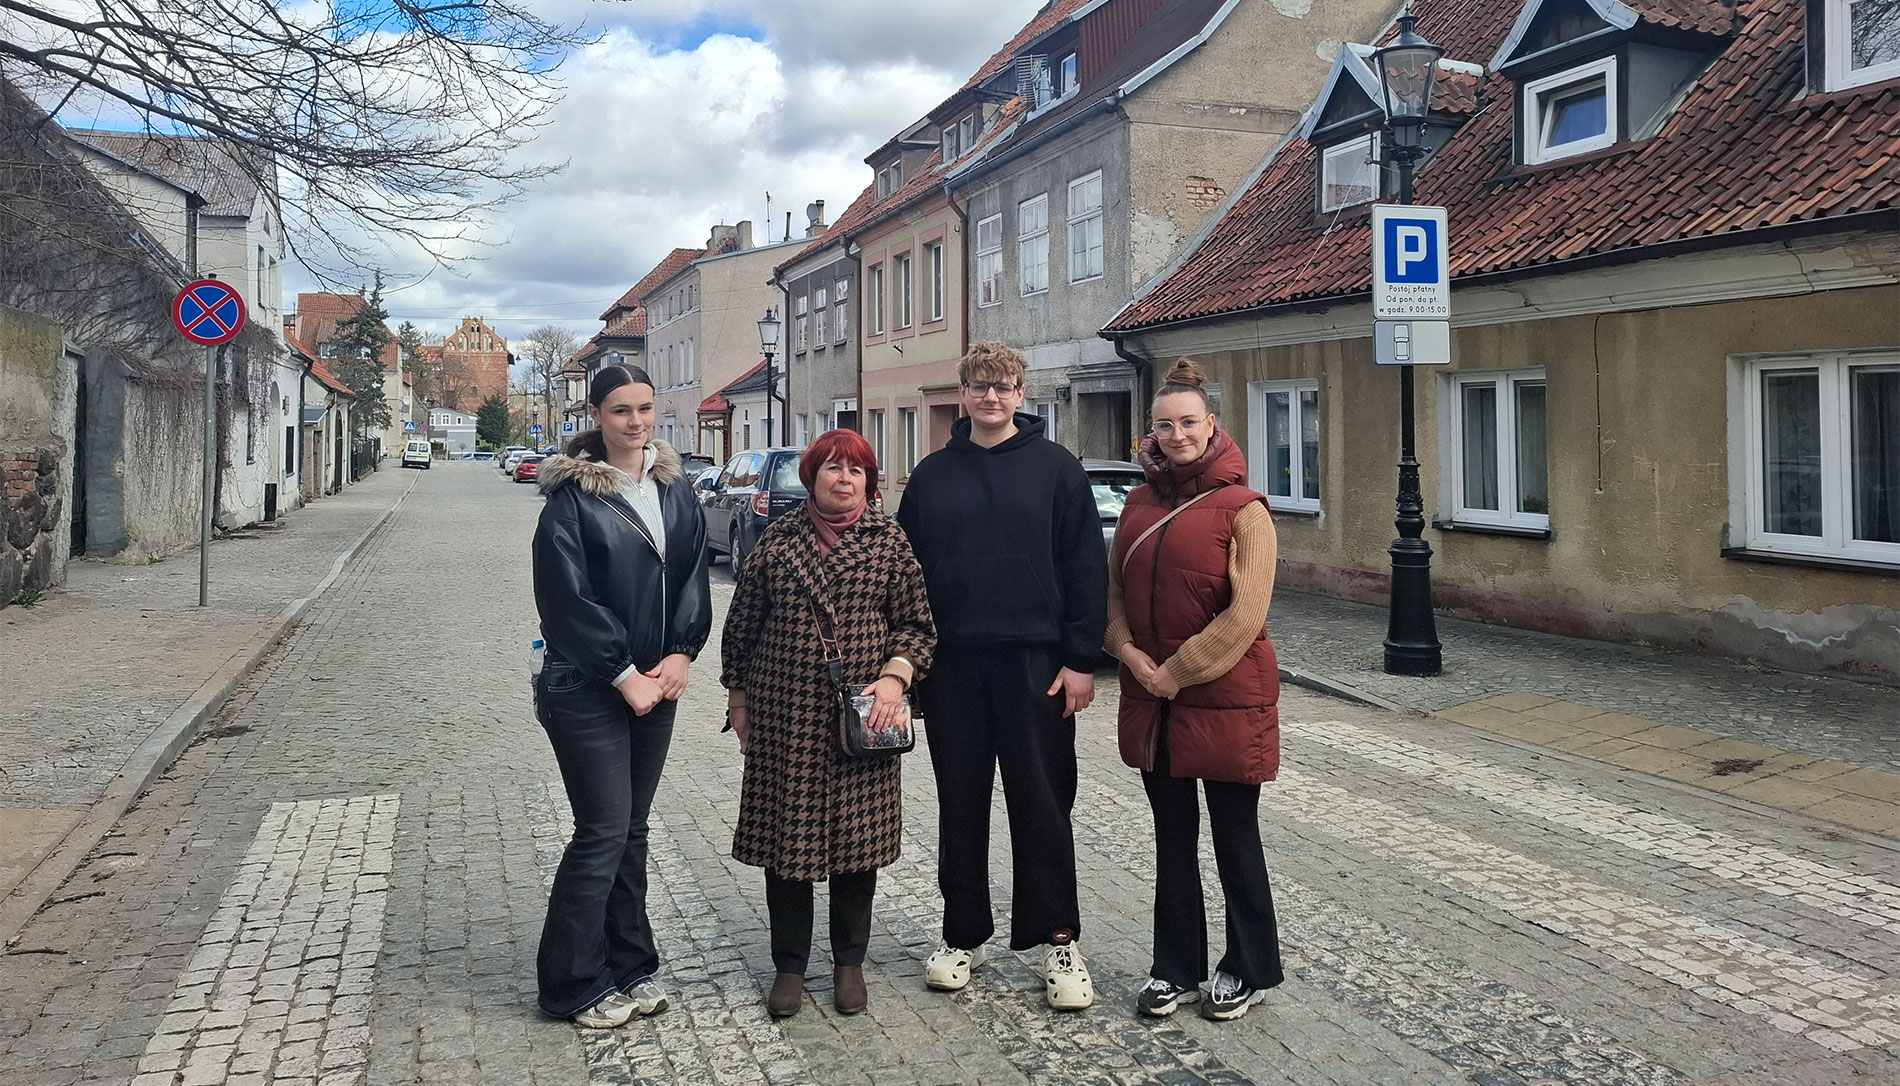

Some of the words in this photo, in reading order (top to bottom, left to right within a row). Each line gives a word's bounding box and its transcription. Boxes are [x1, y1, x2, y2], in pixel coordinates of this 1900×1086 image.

[1396, 225, 1428, 276] P
[1386, 295, 1396, 303] Od
[1429, 296, 1439, 304] pt.
[1387, 306, 1406, 315] godz.
[565, 423, 571, 431] P
